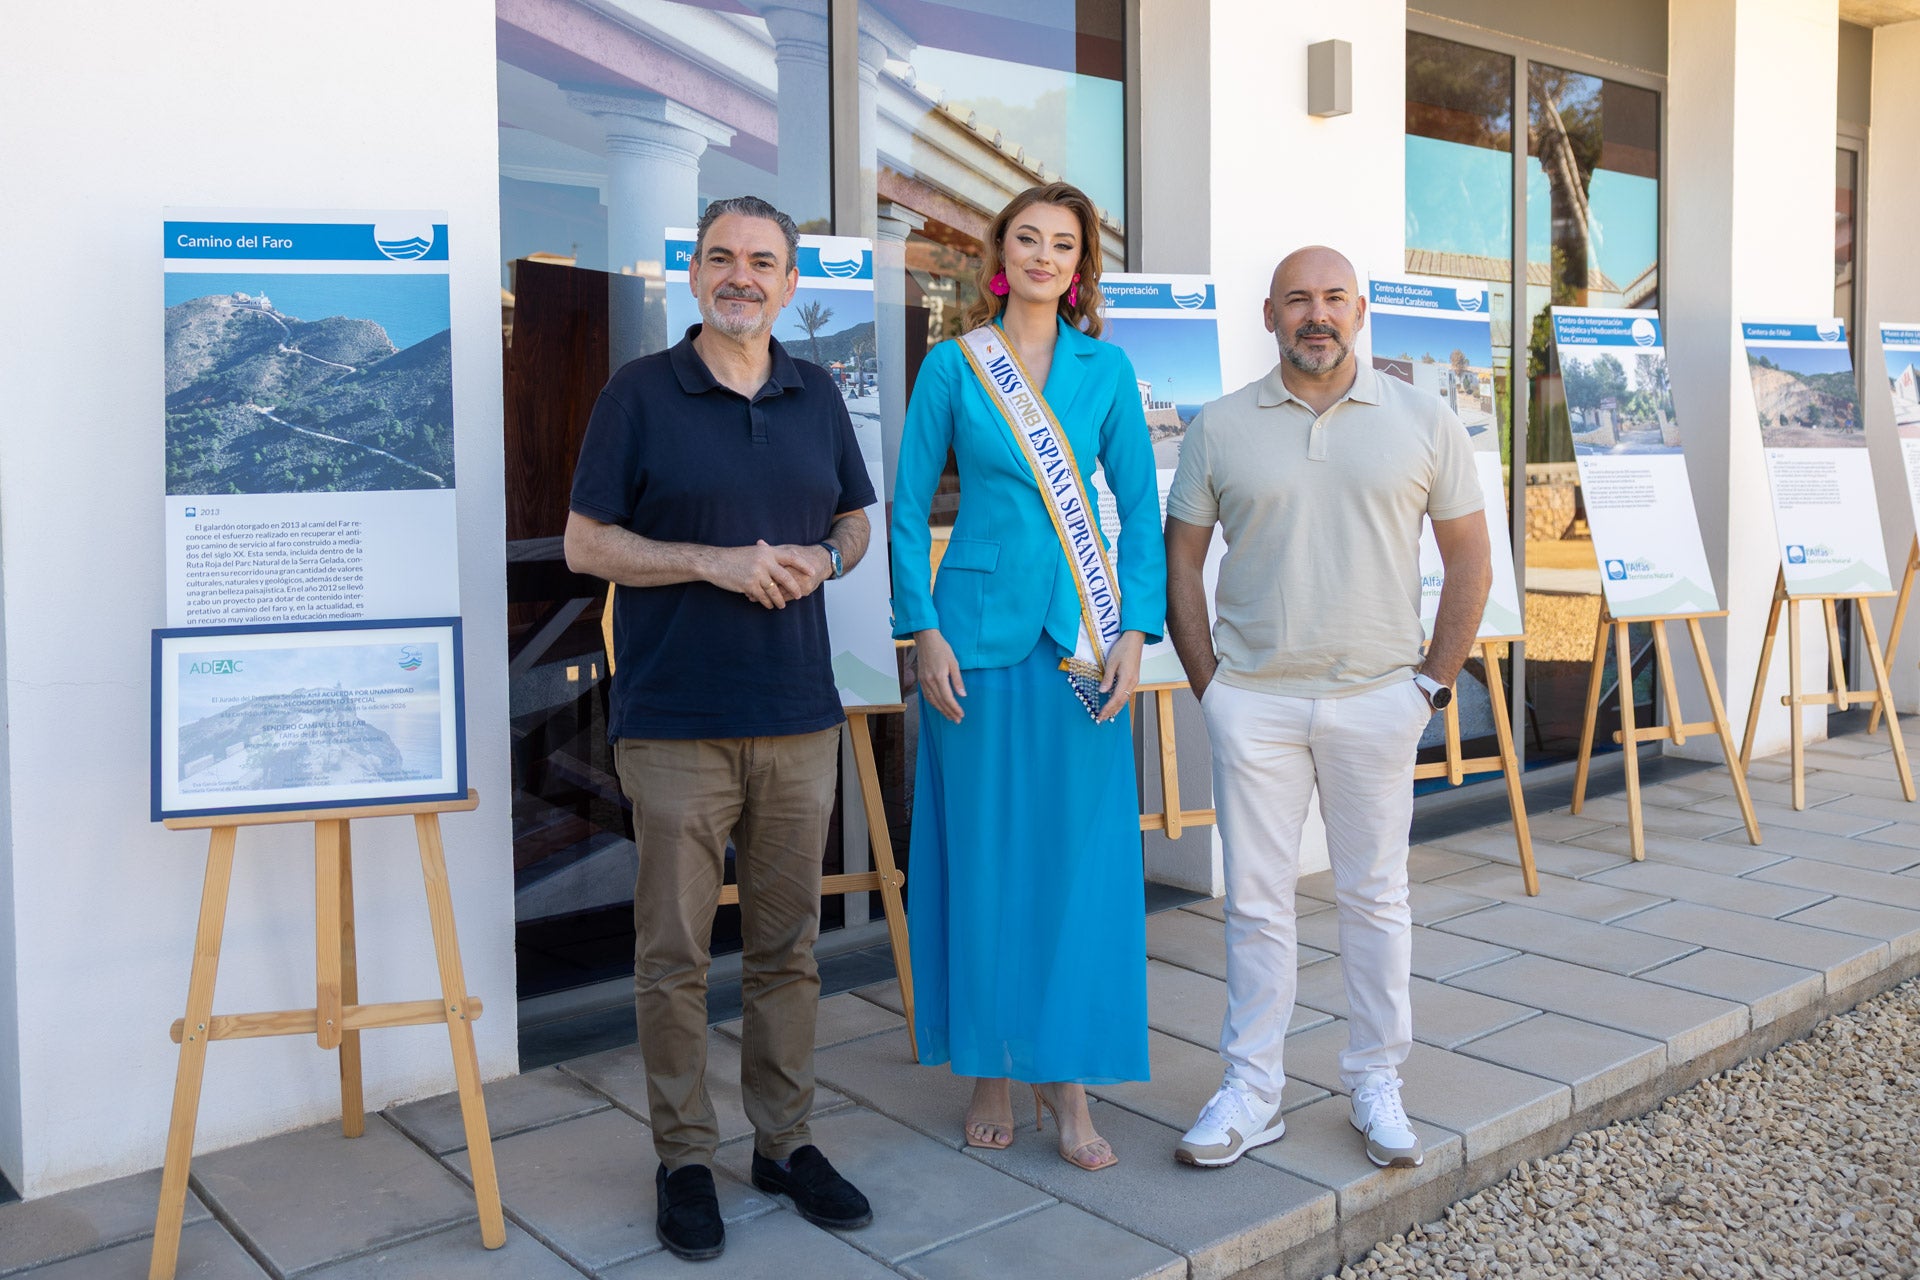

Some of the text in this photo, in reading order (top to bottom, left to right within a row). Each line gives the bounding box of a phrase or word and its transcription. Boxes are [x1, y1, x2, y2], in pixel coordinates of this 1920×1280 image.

[177, 234, 293, 248] Camino del Faro
[676, 251, 691, 262] Pla
[1101, 285, 1159, 296] Interpretación
[1374, 283, 1433, 296] Centro de Educación
[1375, 294, 1439, 308] Ambiental Carabineros
[986, 355, 1022, 393] MISS
[1012, 392, 1041, 427] RNB
[1028, 426, 1072, 497] ESPAÑA
[1060, 497, 1121, 643] SUPRANACIONAL
[203, 524, 235, 532] galardón
[236, 523, 269, 531] otorgado
[255, 531, 288, 539] realizado
[293, 539, 331, 547] construido
[214, 551, 231, 559] siglo
[187, 608, 221, 616] pretativo
[291, 612, 327, 620] educación
[190, 660, 244, 674] ADEAC
[322, 690, 353, 698] ACUERDA
[369, 687, 415, 695] UNANIMIDAD
[284, 699, 346, 708] RECONOCIMIENTO
[262, 723, 296, 732] SENDERO
